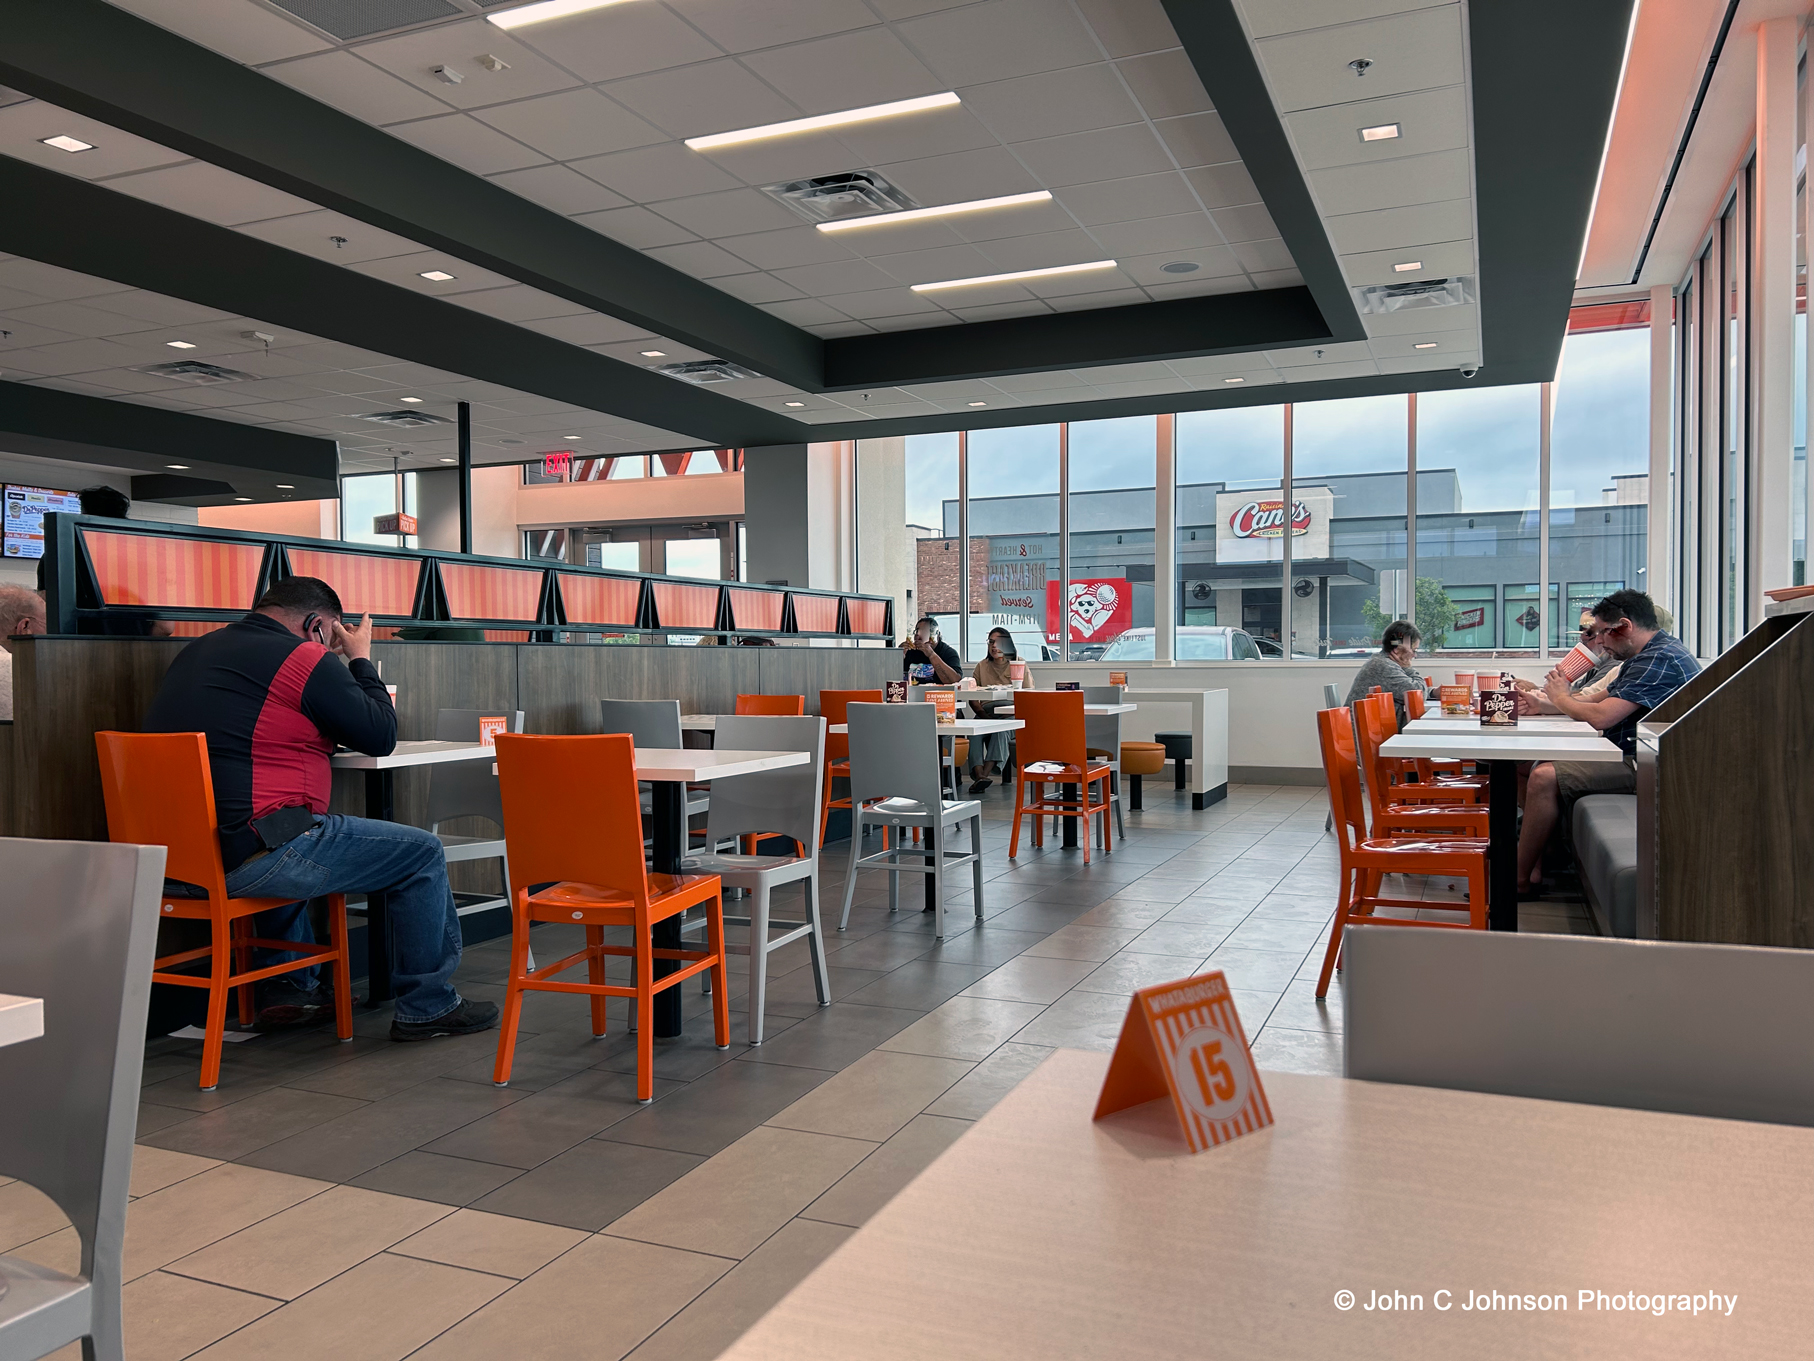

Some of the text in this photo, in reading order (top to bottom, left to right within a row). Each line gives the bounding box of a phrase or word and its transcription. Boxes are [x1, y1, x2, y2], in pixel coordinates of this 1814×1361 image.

[546, 453, 570, 474] EXIT
[1260, 503, 1284, 511] Raisin
[389, 520, 397, 531] UP
[1492, 694, 1506, 702] Dr
[1484, 699, 1515, 711] Pepper
[1147, 977, 1227, 1016] WHATABURGER
[1189, 1038, 1236, 1108] 15
